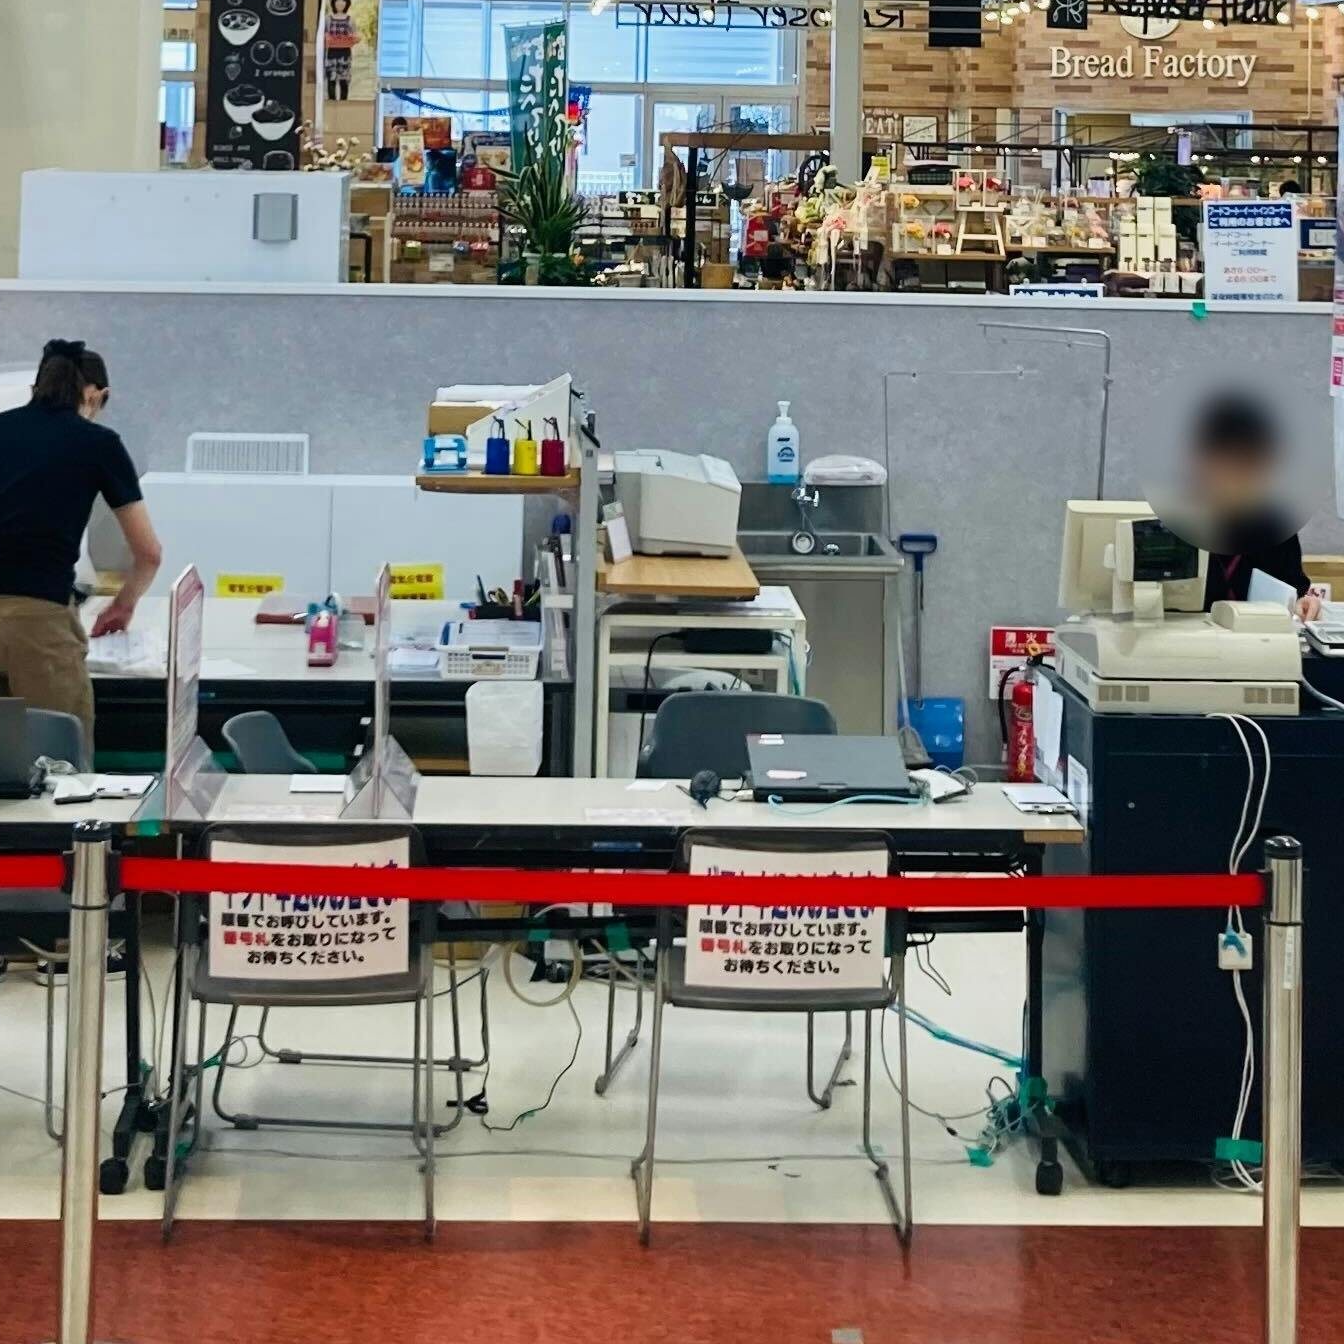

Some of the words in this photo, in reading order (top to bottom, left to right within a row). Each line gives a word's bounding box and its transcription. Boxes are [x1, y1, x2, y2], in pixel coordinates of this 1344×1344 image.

[1049, 45, 1134, 79] Bread
[1142, 46, 1258, 87] Factory
[221, 910, 392, 929] 順番でお呼びしています。
[698, 918, 868, 937] 順番でお呼びしています。
[223, 926, 397, 947] 番号札をお取りになって
[701, 937, 872, 956] 番号札をお取りになって
[247, 950, 366, 965] お待ちください。
[723, 958, 841, 974] お待ちください。
